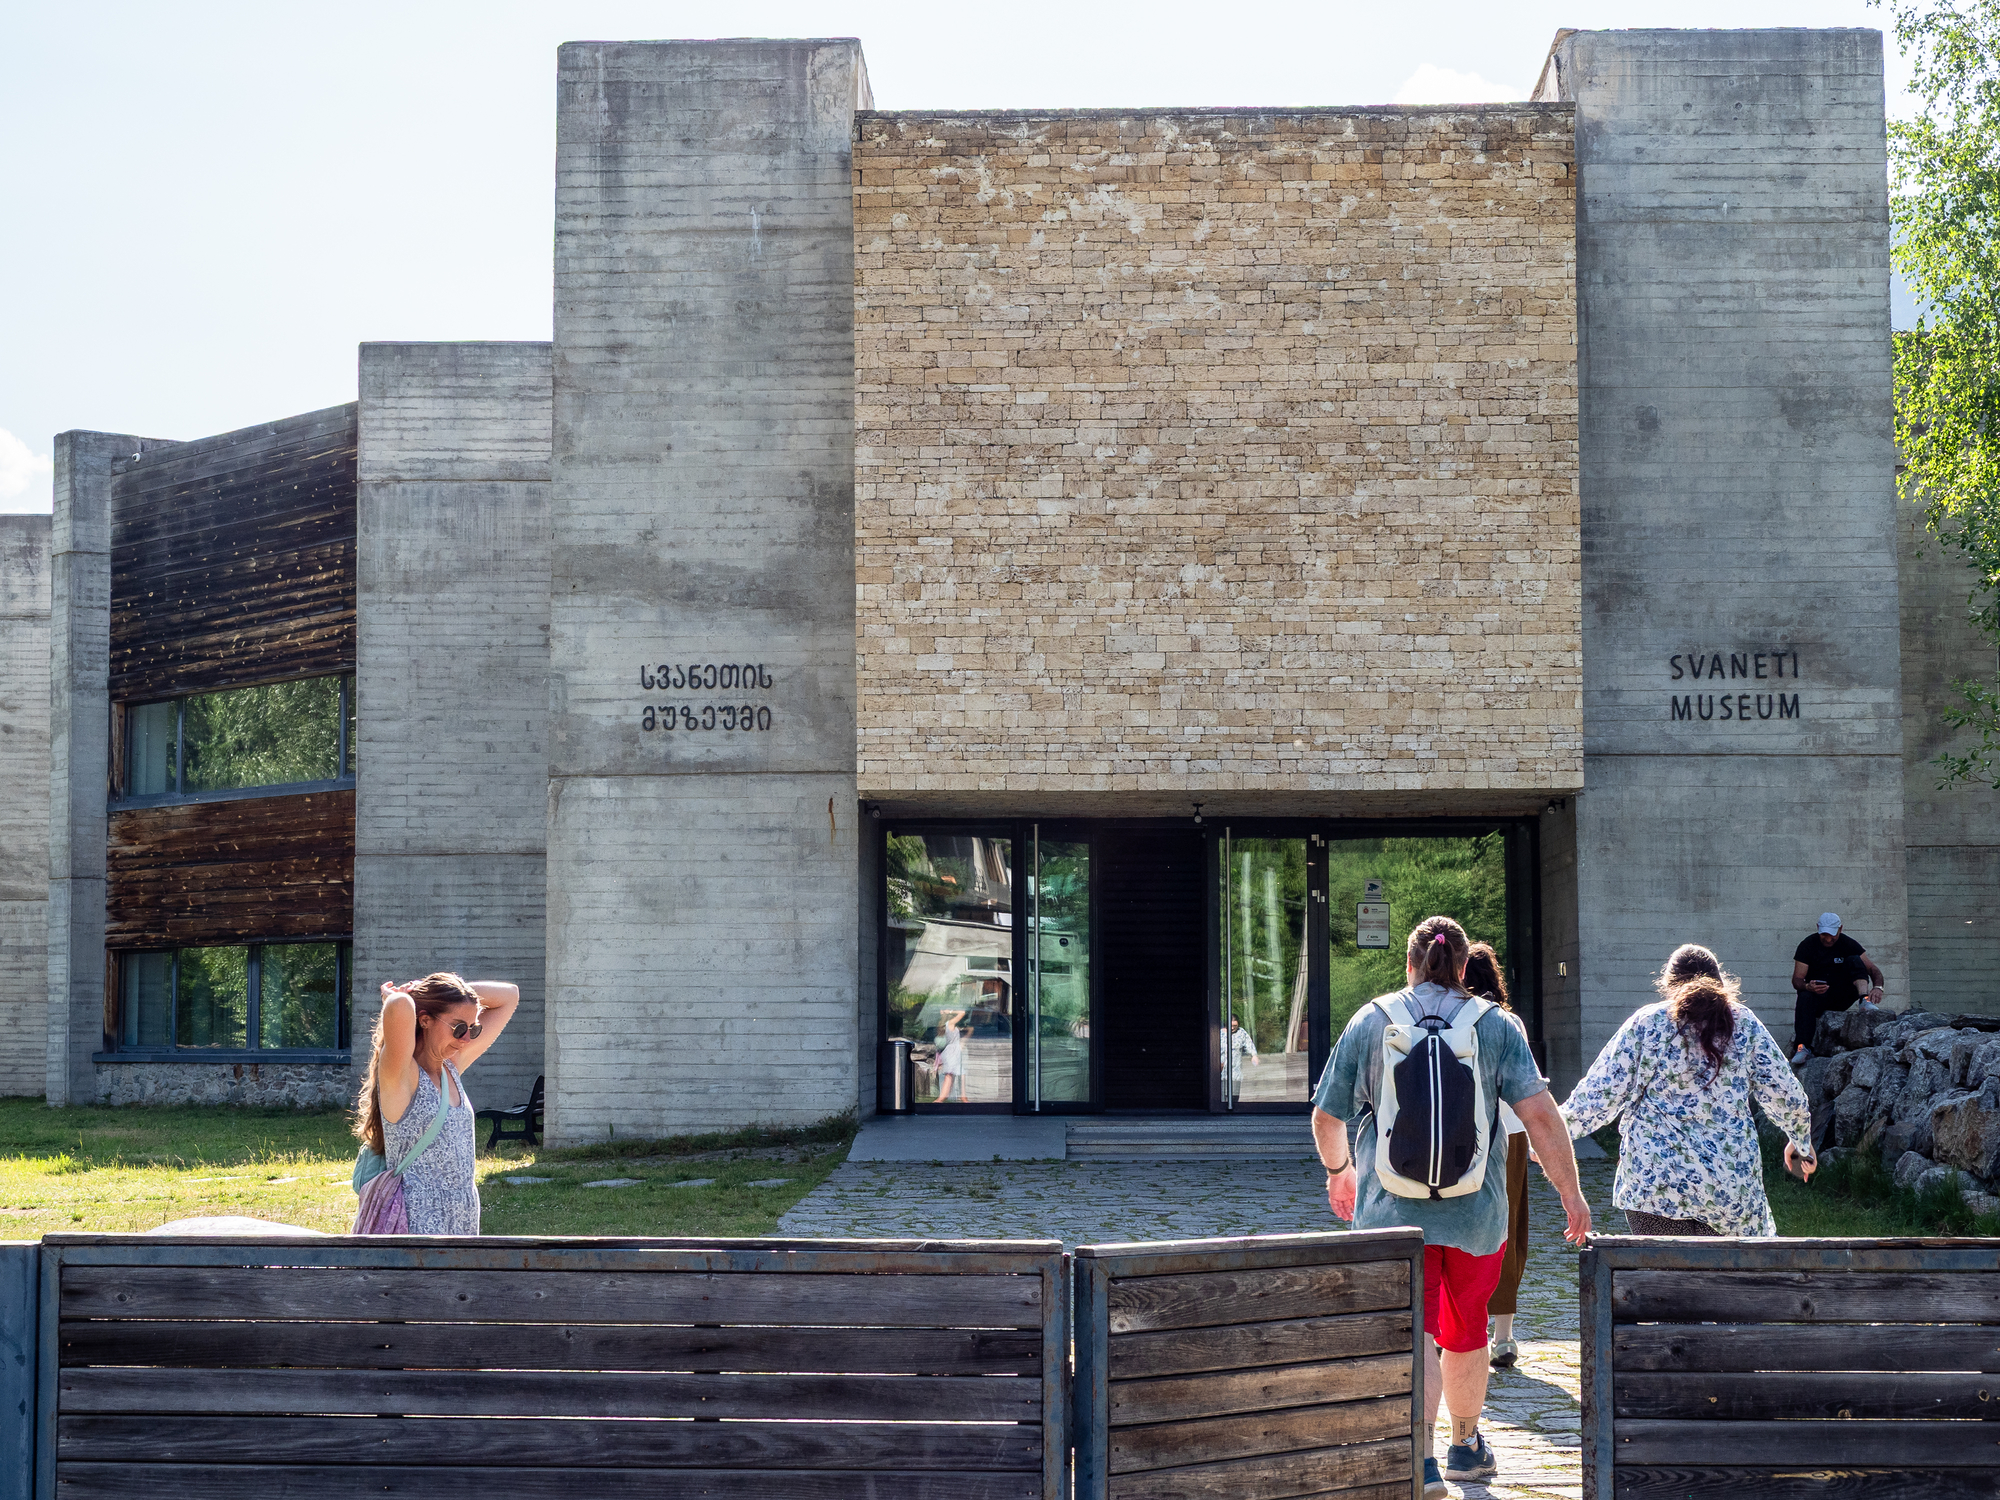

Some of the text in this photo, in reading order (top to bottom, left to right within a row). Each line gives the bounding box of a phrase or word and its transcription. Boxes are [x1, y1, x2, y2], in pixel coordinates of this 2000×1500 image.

[640, 664, 773, 690] სვანეთის
[1669, 652, 1800, 680] SVANETI
[641, 705, 773, 732] მუზეუმი
[1671, 693, 1800, 721] MUSEUM
